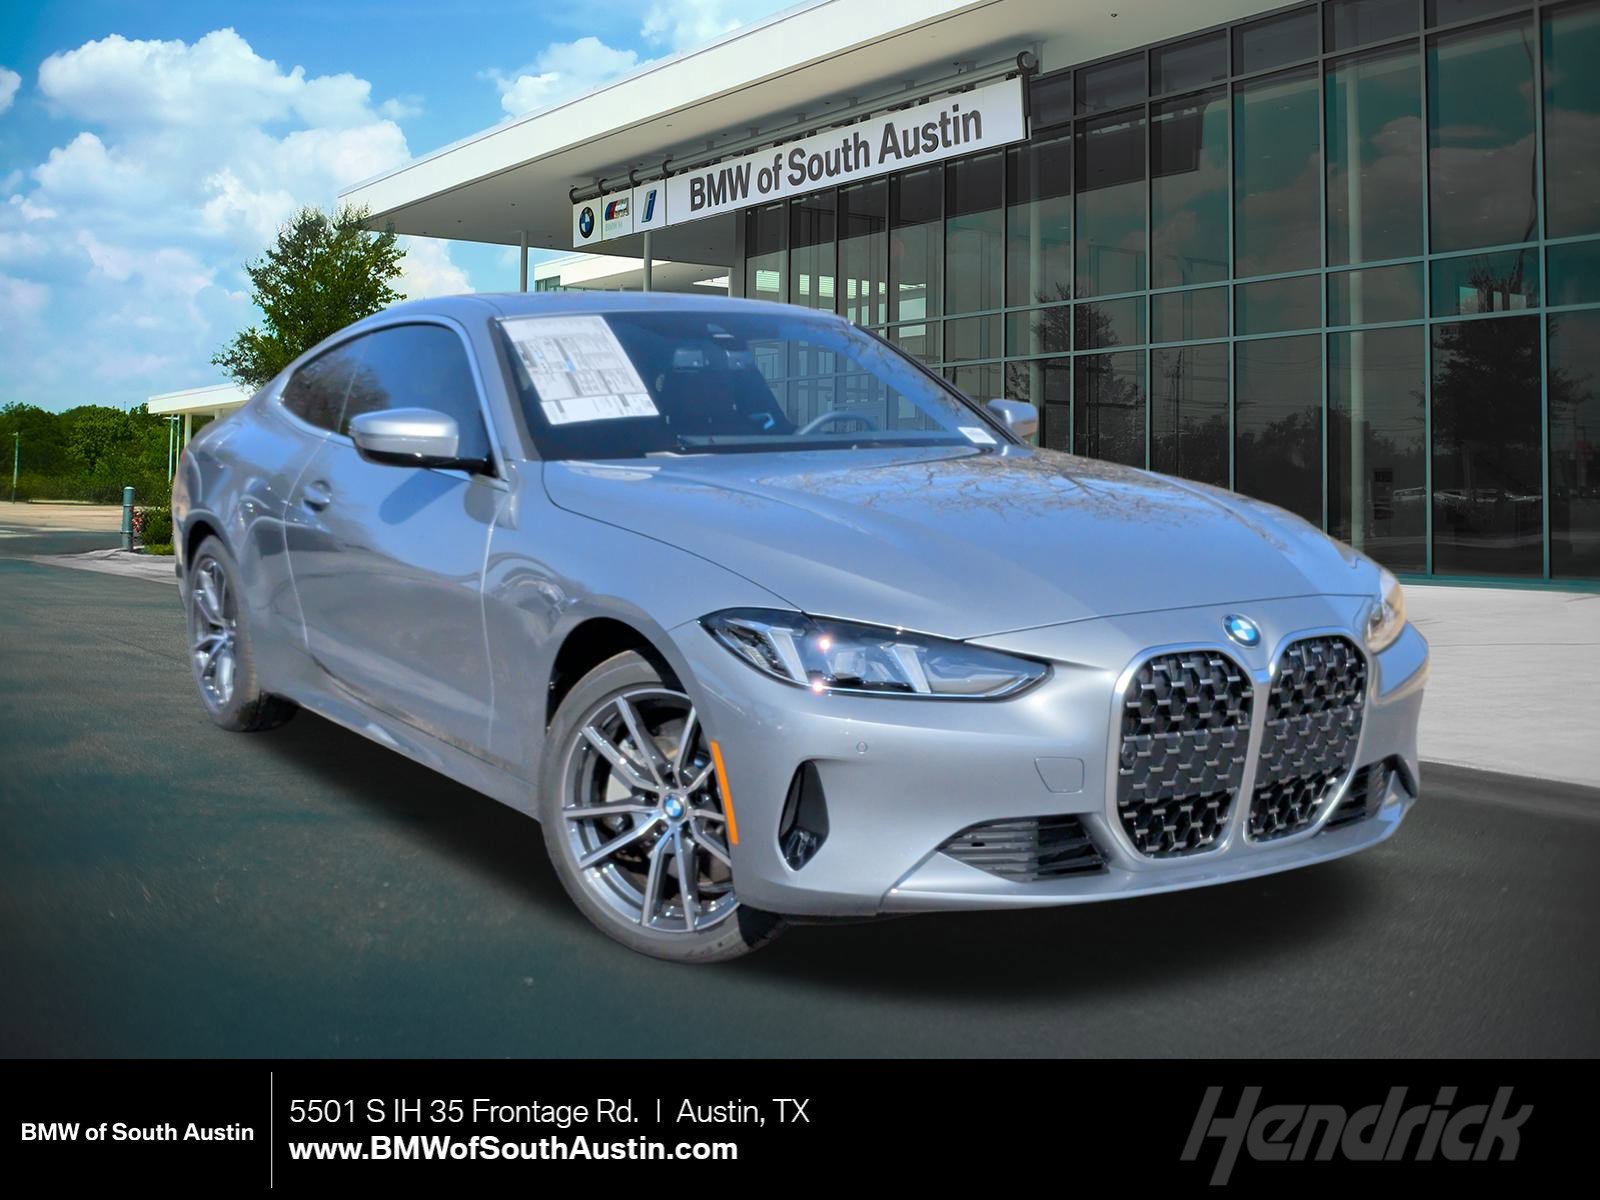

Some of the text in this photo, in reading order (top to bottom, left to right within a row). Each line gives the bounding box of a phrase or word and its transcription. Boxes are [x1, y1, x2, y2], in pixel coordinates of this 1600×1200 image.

[690, 103, 982, 211] BMW of South Austin
